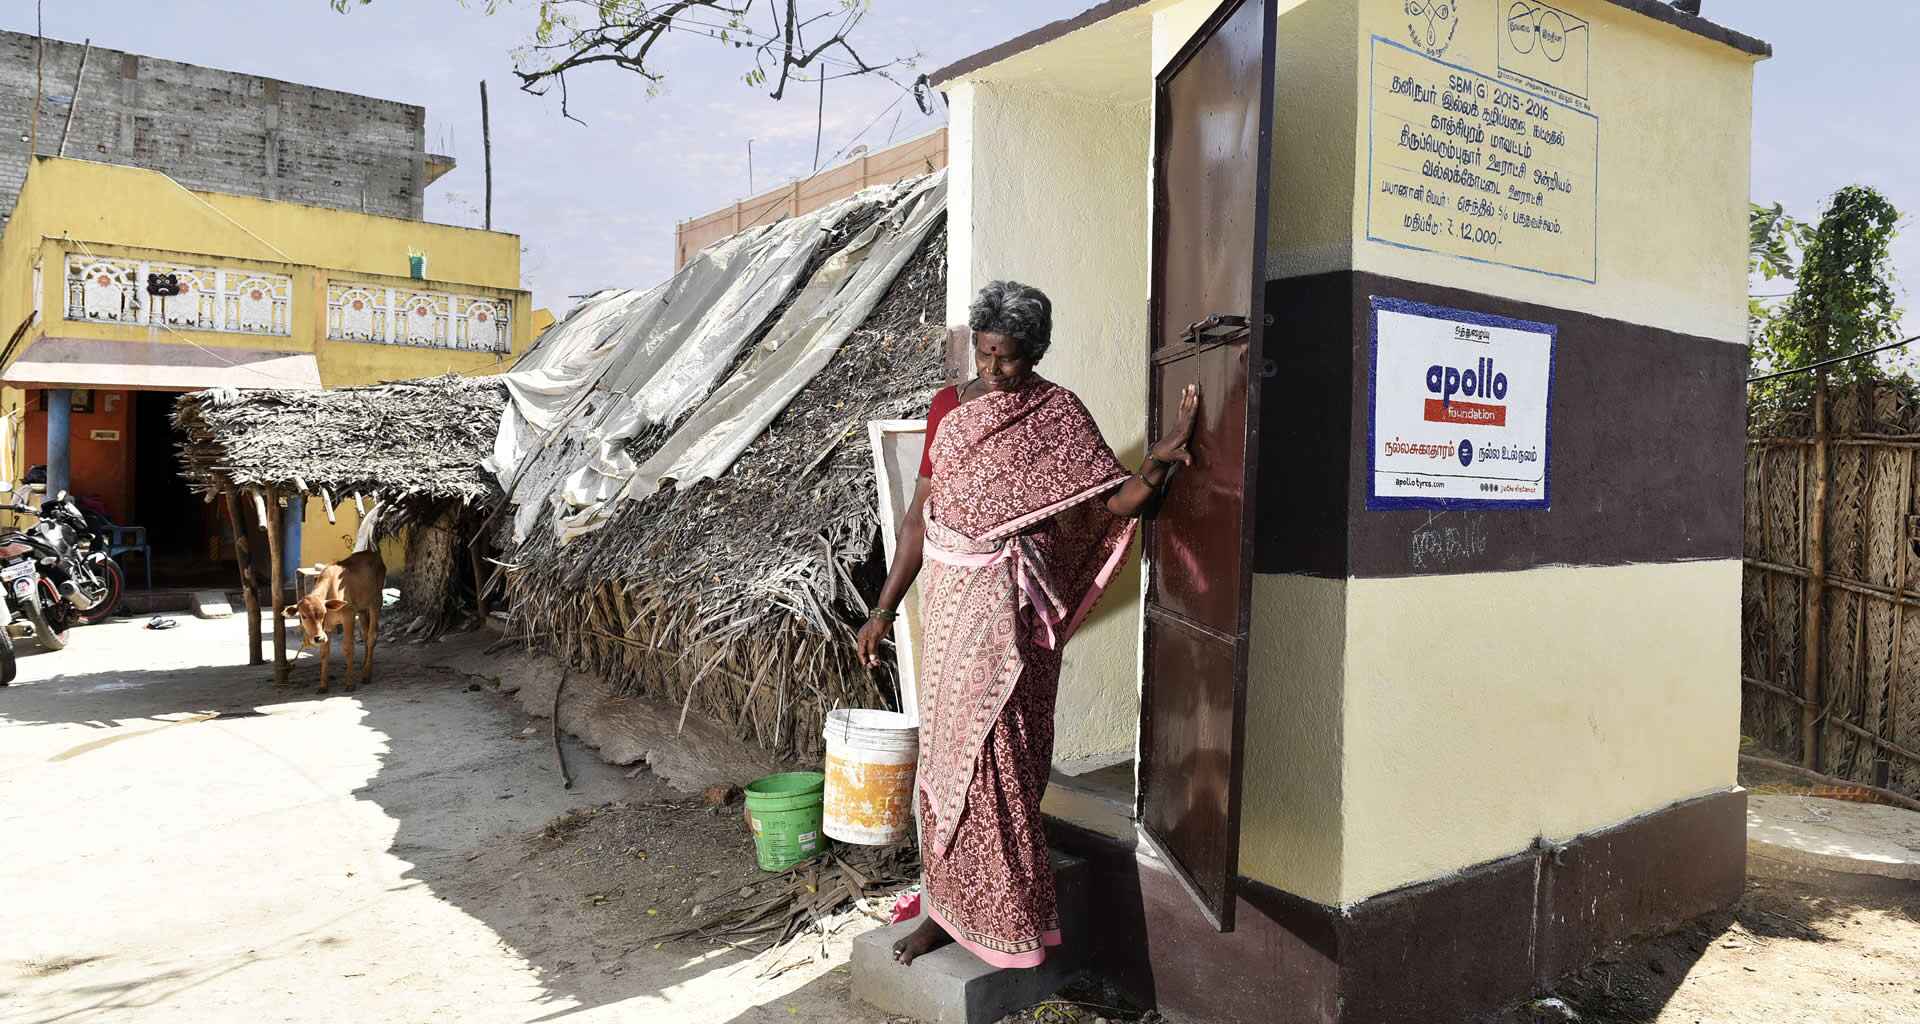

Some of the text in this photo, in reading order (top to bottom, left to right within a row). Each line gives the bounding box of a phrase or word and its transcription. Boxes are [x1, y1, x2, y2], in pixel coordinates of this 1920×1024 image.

[1389, 75, 1438, 105] தனிநபர்
[1430, 114, 1533, 159] காஞ்சிபுரம் மாவட்டம்
[1486, 153, 1527, 179] ஊராட்சி
[1533, 168, 1573, 194] ஒன்றியம்
[1457, 195, 1495, 217] செந்தில்
[1508, 184, 1544, 207] ஊராட்சி
[1426, 357, 1508, 408] apollo
[1448, 406, 1496, 420] foundation
[1478, 442, 1501, 463] நல்ல
